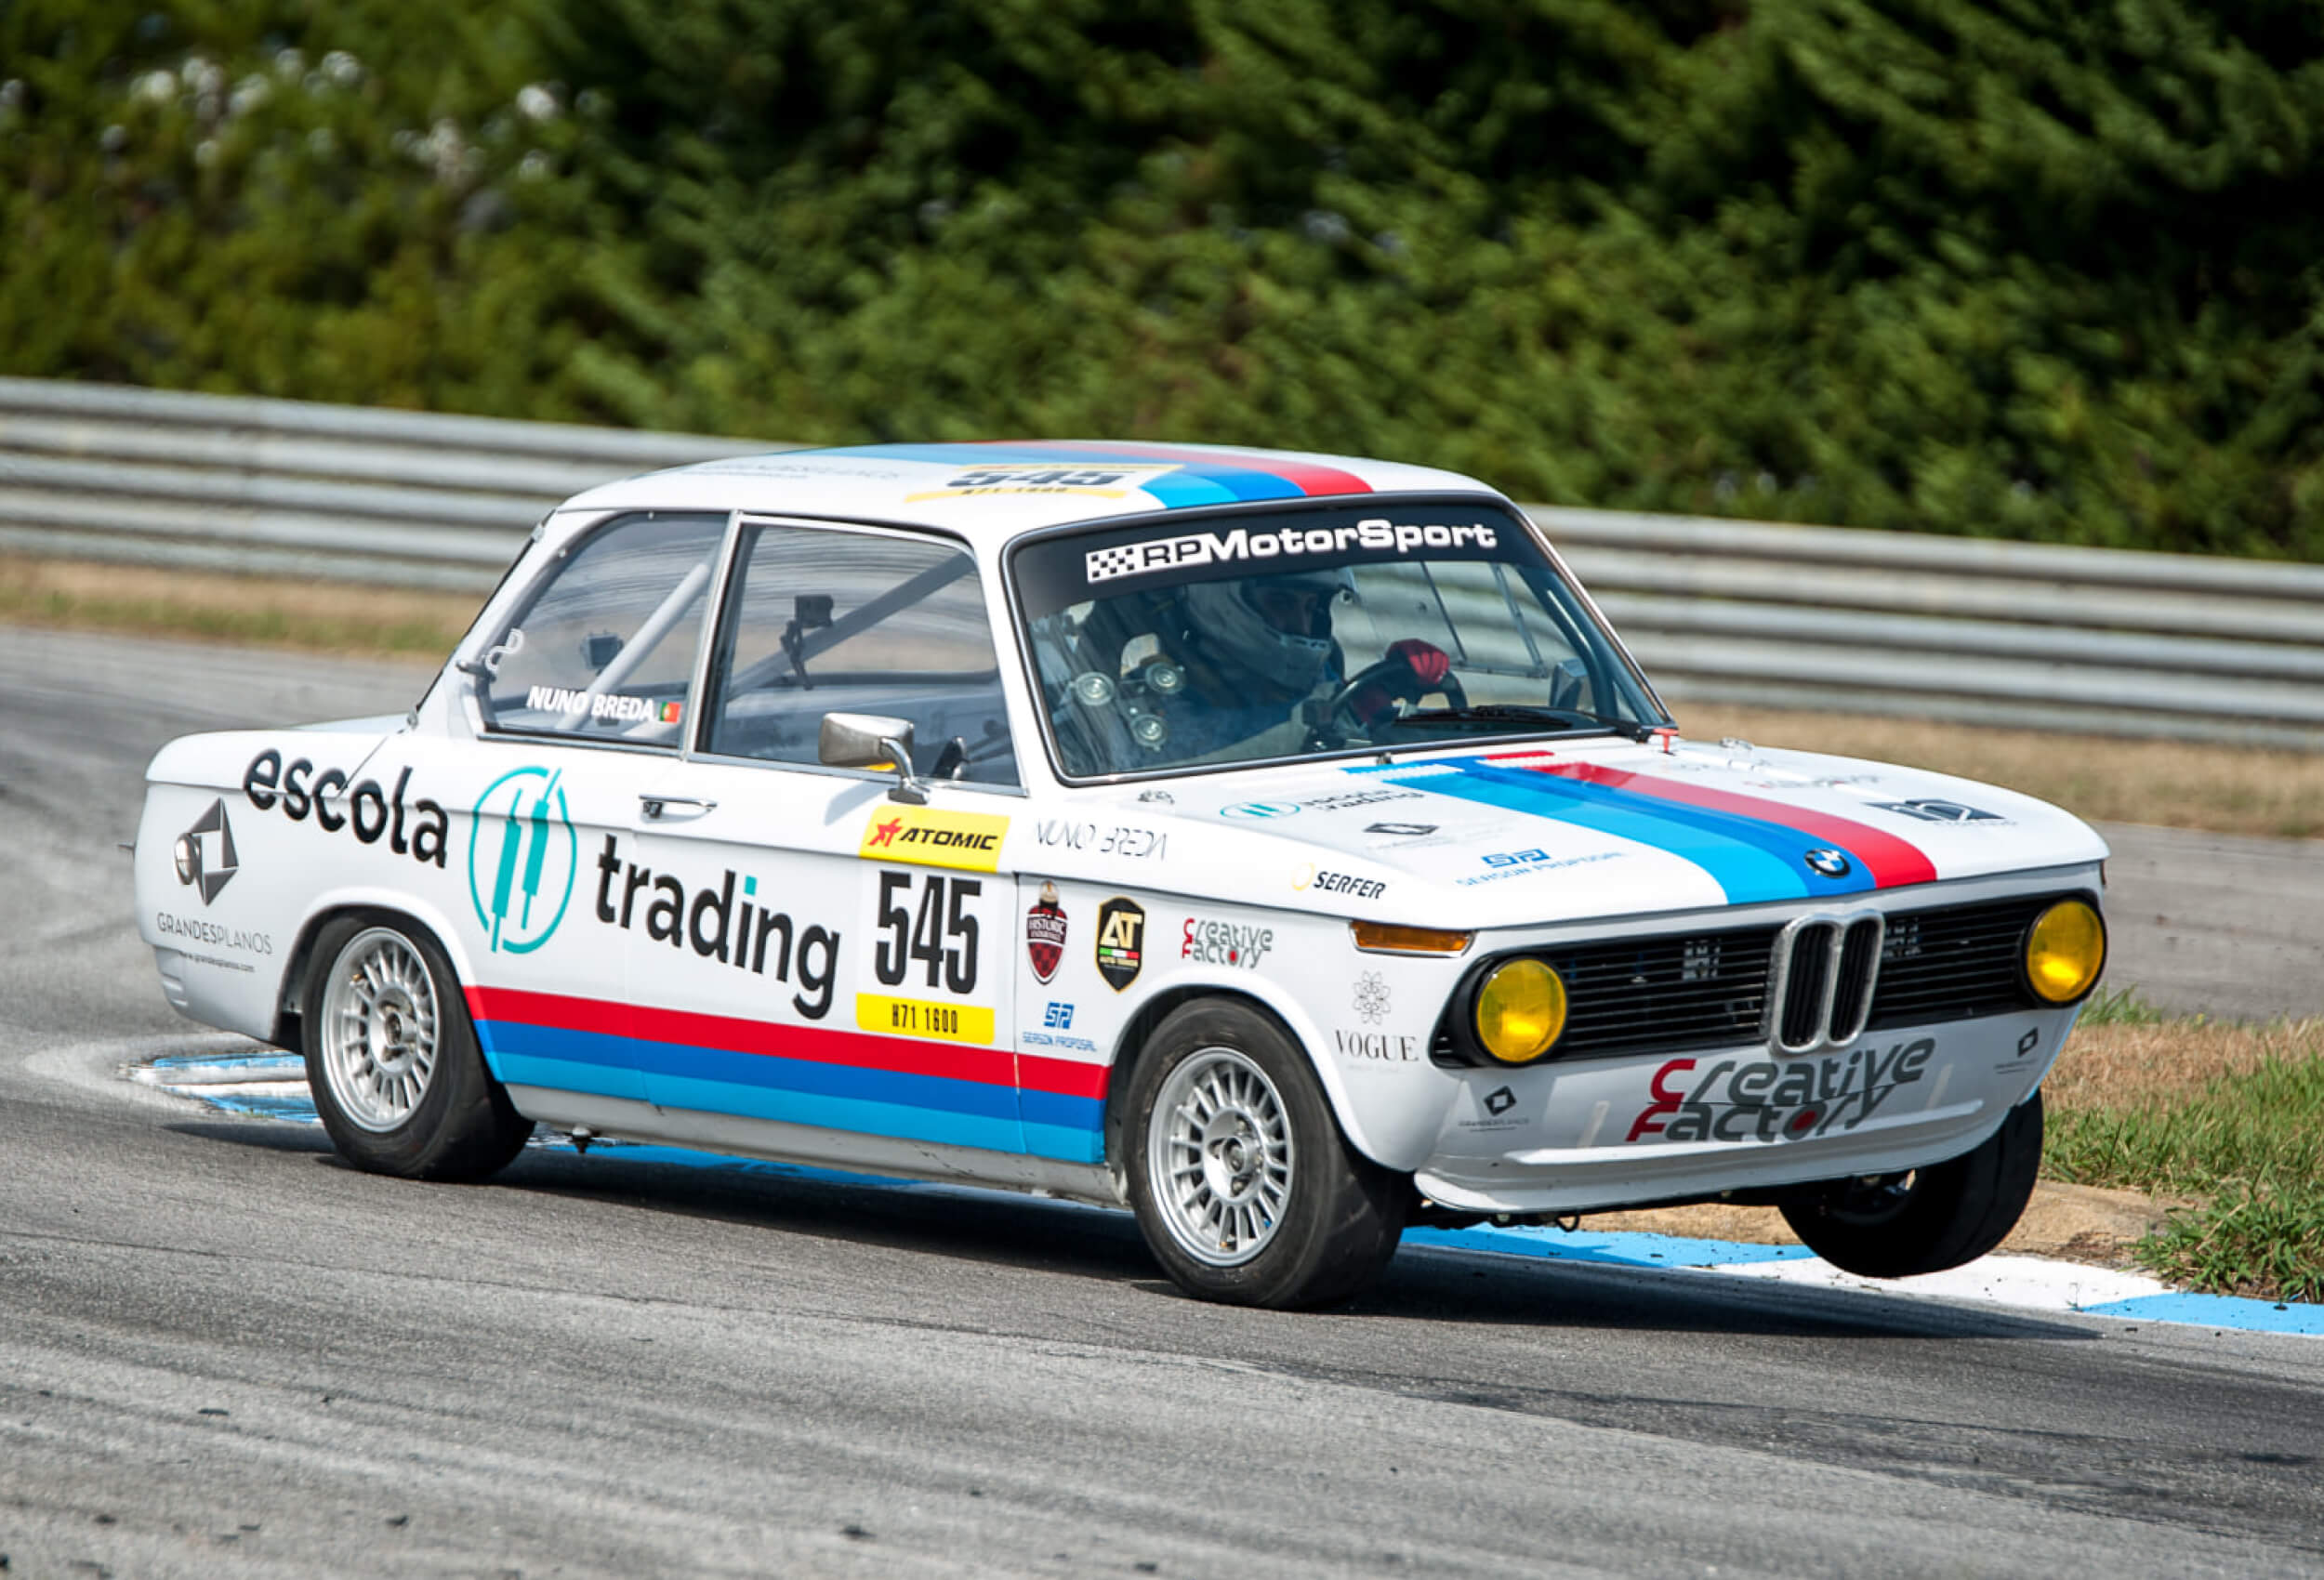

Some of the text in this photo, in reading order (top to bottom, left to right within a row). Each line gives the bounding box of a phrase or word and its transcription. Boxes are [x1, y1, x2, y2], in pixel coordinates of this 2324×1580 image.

[946, 469, 1135, 487] 545
[526, 685, 656, 721] NUNO BREDA
[899, 827, 999, 850] ATOMIC
[244, 748, 840, 1020] escola trading
[1313, 870, 1387, 900] SERFER
[156, 911, 273, 955] GRANDESPLANOS
[875, 870, 983, 994] 545
[1100, 910, 1142, 949] AT
[1183, 916, 1274, 951] Creative
[1181, 937, 1264, 968] Factory
[891, 1003, 958, 1034] H71 1600
[1334, 1029, 1419, 1061] VOGUE
[1649, 1037, 1936, 1107] Creative
[1625, 1083, 1898, 1143] Factory
